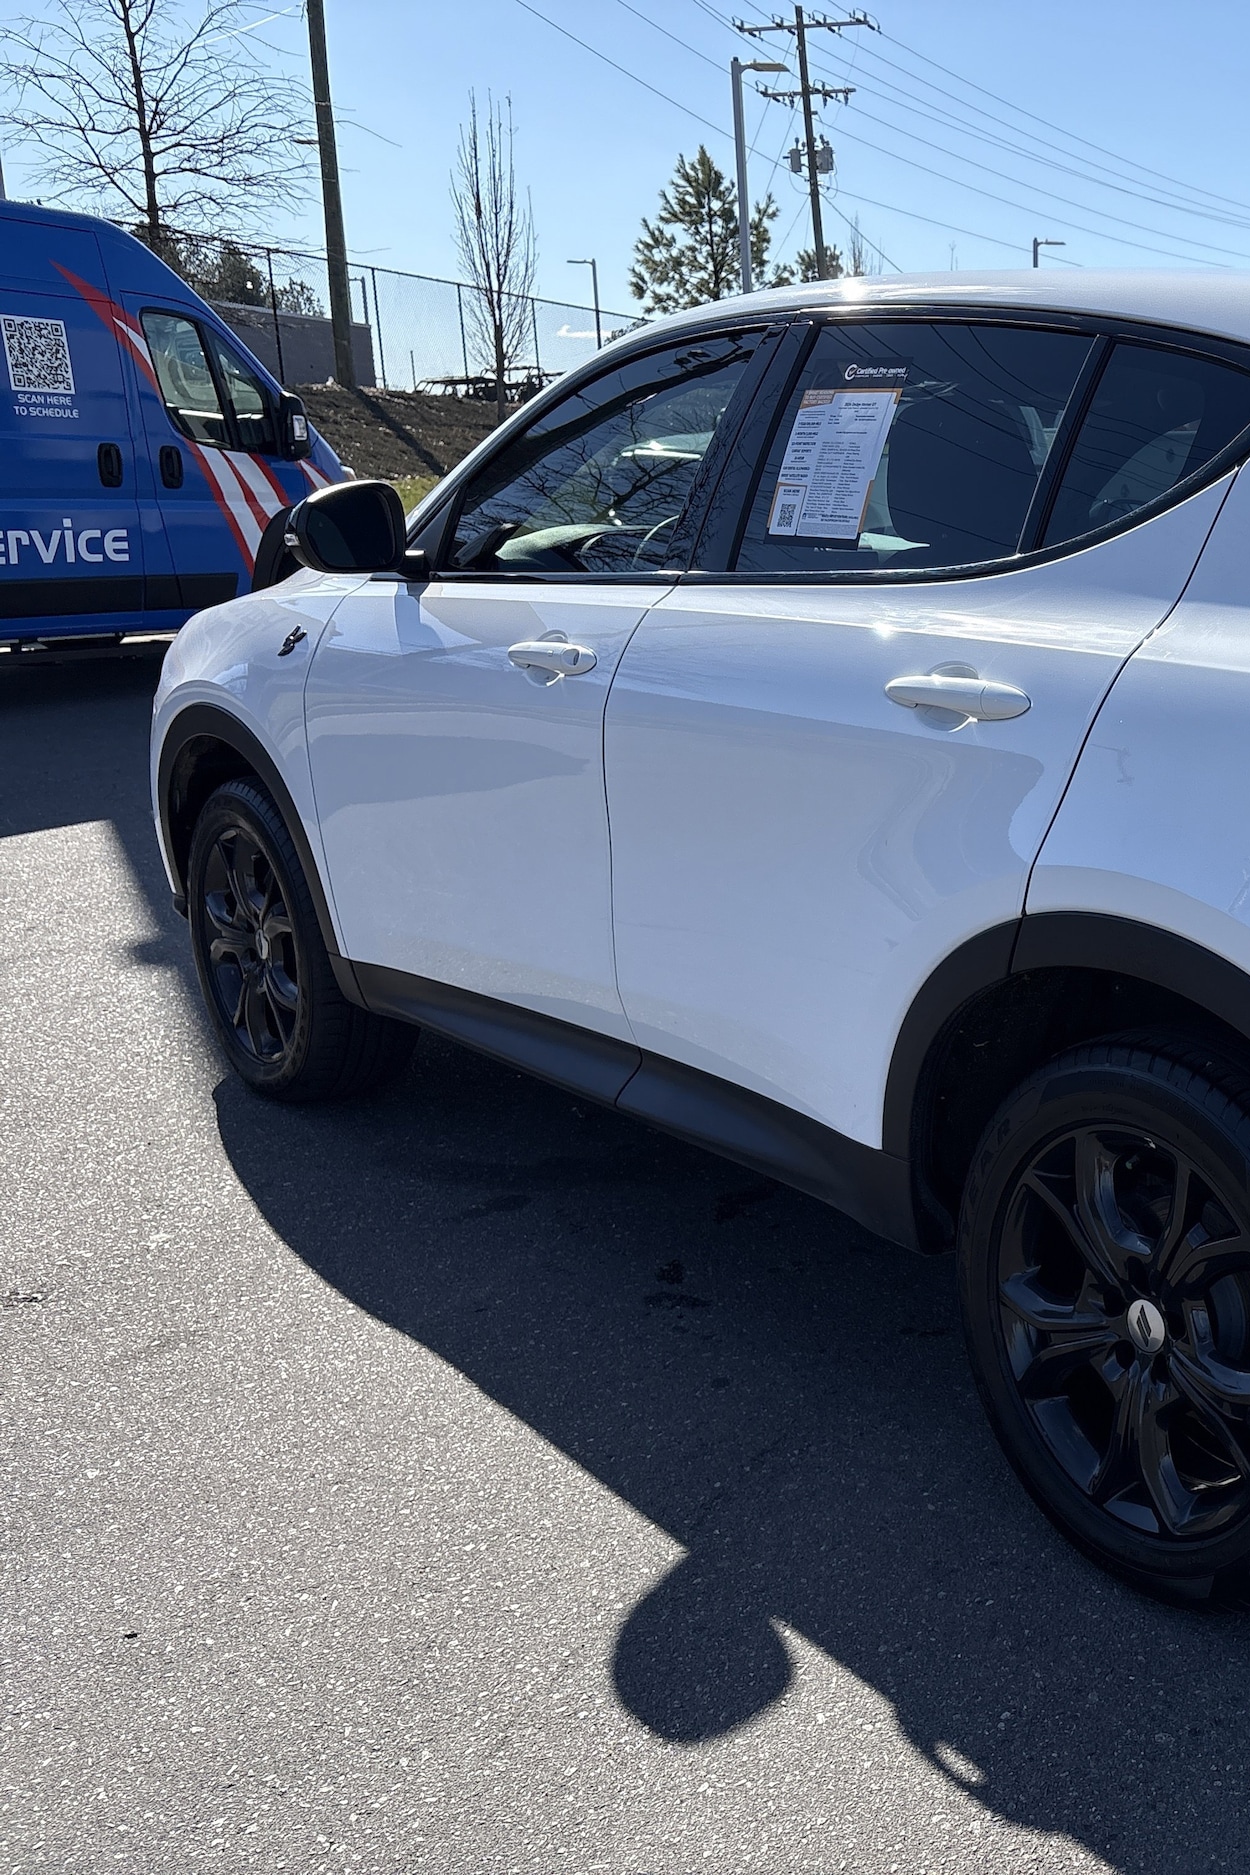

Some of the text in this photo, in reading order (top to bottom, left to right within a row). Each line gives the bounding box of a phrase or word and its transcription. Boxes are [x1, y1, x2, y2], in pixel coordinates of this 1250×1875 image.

[856, 367, 878, 375] Certified
[17, 394, 72, 406] SCAN HERE
[13, 406, 80, 418] TO SCHEDULE
[0, 517, 130, 565] rvice
